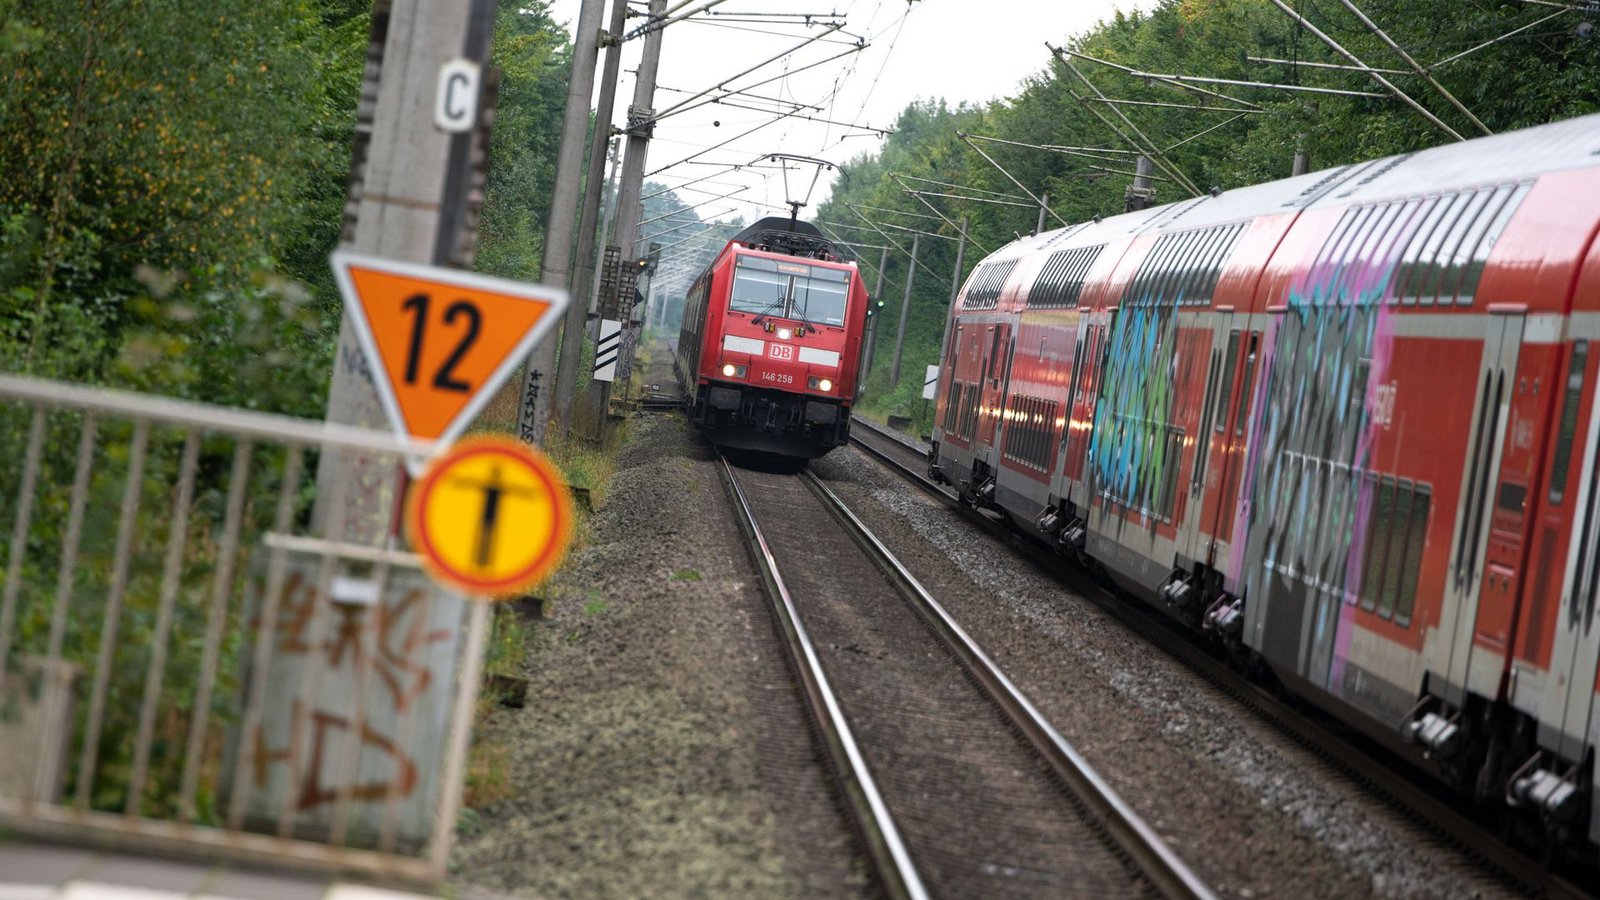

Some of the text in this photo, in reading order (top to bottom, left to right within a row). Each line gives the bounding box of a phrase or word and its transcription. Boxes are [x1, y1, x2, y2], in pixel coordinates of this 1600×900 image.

[444, 72, 469, 120] C
[402, 294, 482, 392] 12
[771, 345, 791, 358] DB
[762, 371, 793, 384] 146 258
